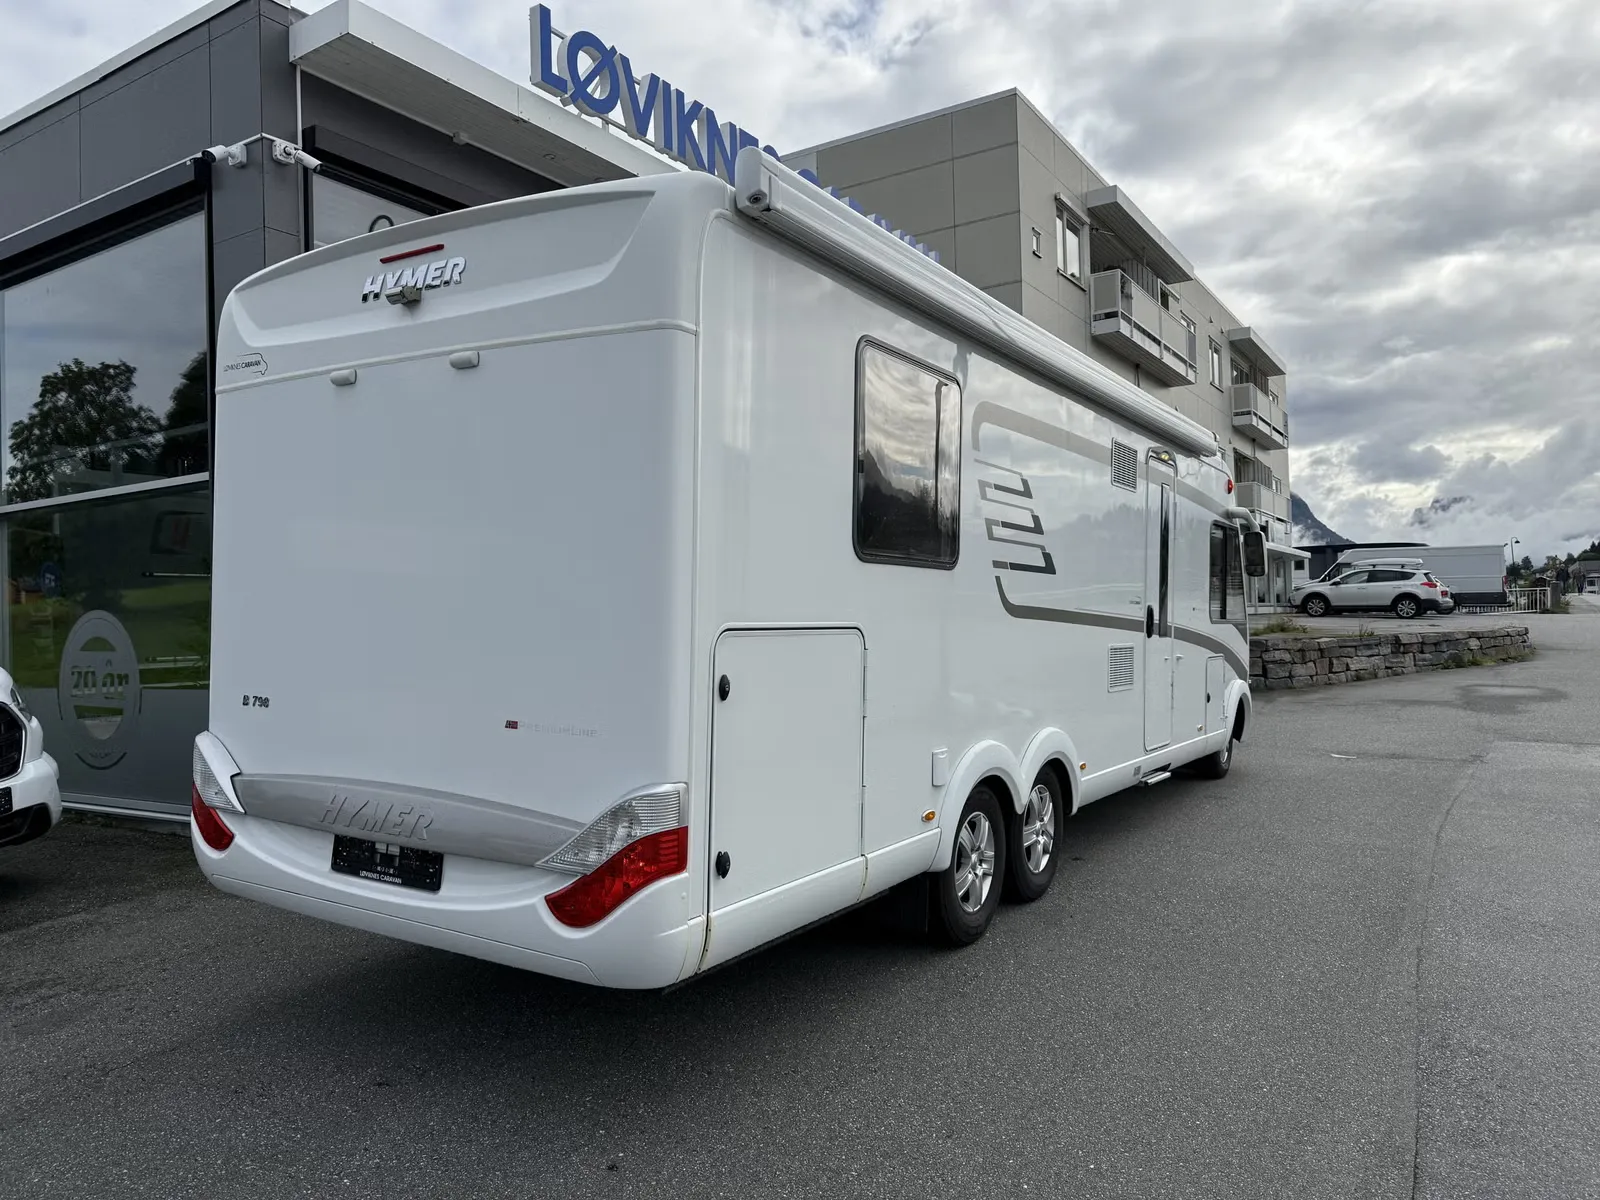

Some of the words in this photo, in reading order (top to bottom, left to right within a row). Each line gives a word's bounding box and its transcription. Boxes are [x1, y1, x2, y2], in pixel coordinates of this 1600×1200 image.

[362, 257, 466, 303] HYMER
[319, 794, 434, 840] HYMER
[380, 874, 402, 884] CARAVAN
